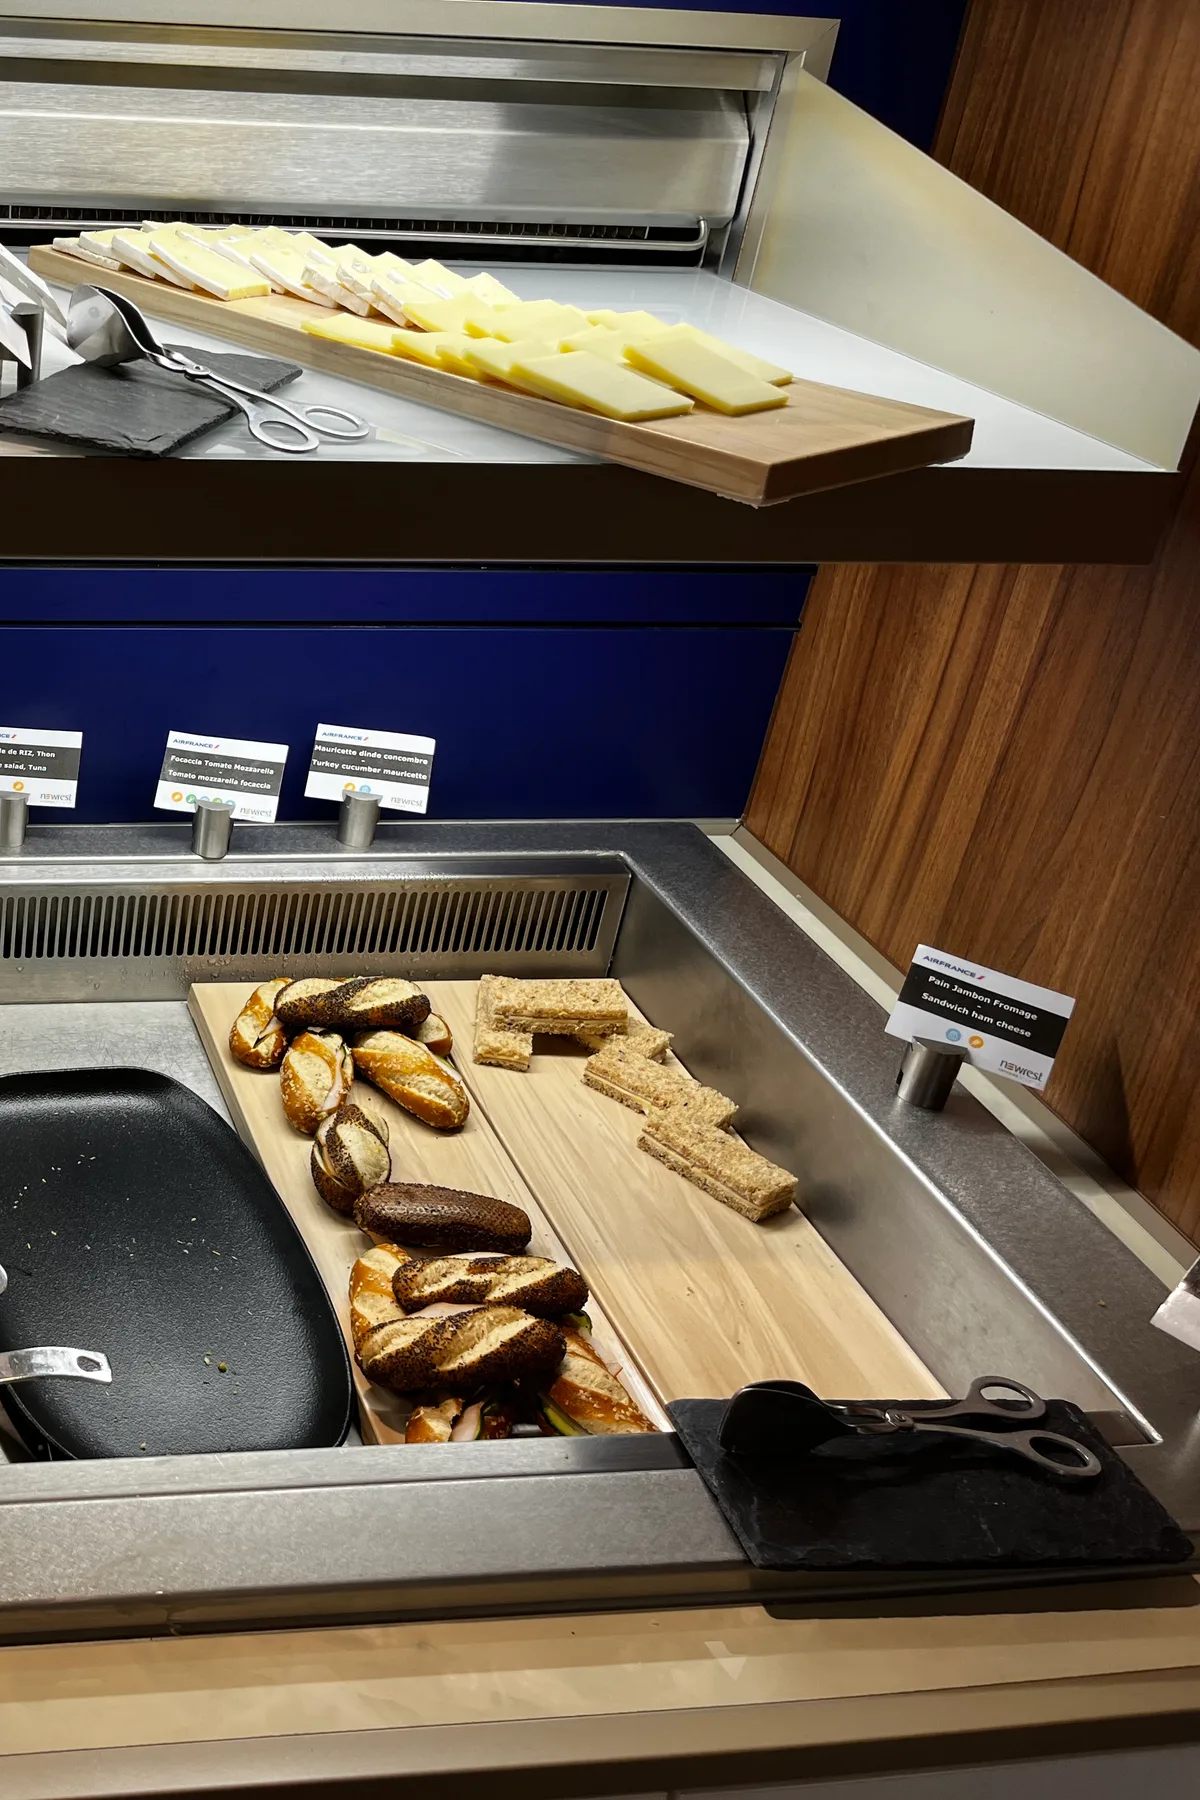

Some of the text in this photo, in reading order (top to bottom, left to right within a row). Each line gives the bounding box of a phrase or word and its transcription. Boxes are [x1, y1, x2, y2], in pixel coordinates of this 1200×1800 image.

[173, 738, 213, 749] AIRFRANCE
[322, 731, 362, 741] AIRFRANCE
[36, 750, 56, 758] Thon
[314, 744, 428, 765] Mauricette dinde concombre
[3, 762, 26, 771] salad,
[28, 764, 47, 772] Tuna
[170, 755, 275, 775] Focaccia Tomate Mozzarella
[312, 758, 428, 780] Turkey cucumber mauricette
[168, 769, 271, 790] Tomato mozzarella focaccia
[40, 792, 72, 802] newrest
[922, 955, 977, 979] AIRFRANCE
[928, 975, 1038, 1021] Pain Jambon Fromage
[921, 992, 1032, 1038] Sandwich ham cheese
[999, 1059, 1044, 1083] newrest
